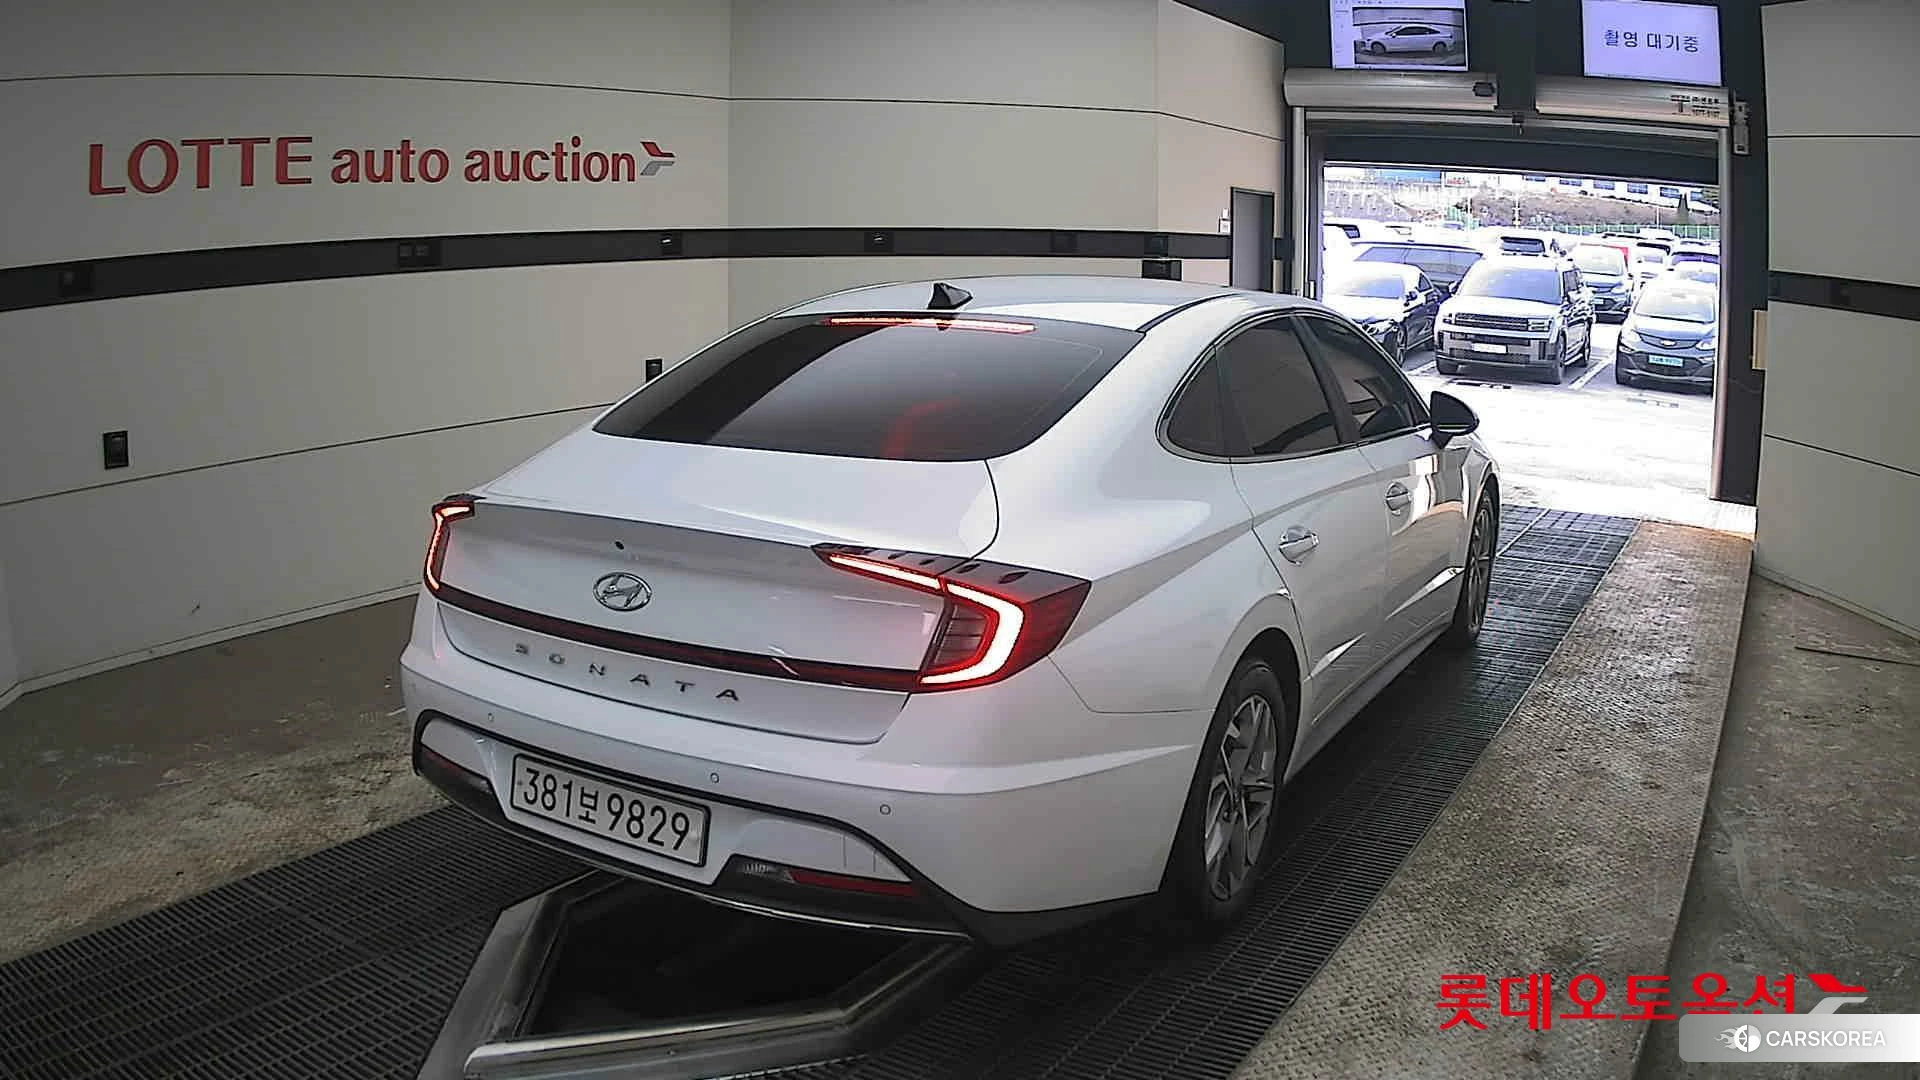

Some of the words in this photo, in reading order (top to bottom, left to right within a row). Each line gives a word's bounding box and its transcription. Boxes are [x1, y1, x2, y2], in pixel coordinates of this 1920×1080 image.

[1646, 33, 1698, 53] 대기중
[89, 136, 312, 195] LOTTE
[331, 139, 450, 184] auto
[463, 135, 636, 183] auction
[515, 643, 739, 701] SONATA
[523, 767, 690, 851] 381보9829
